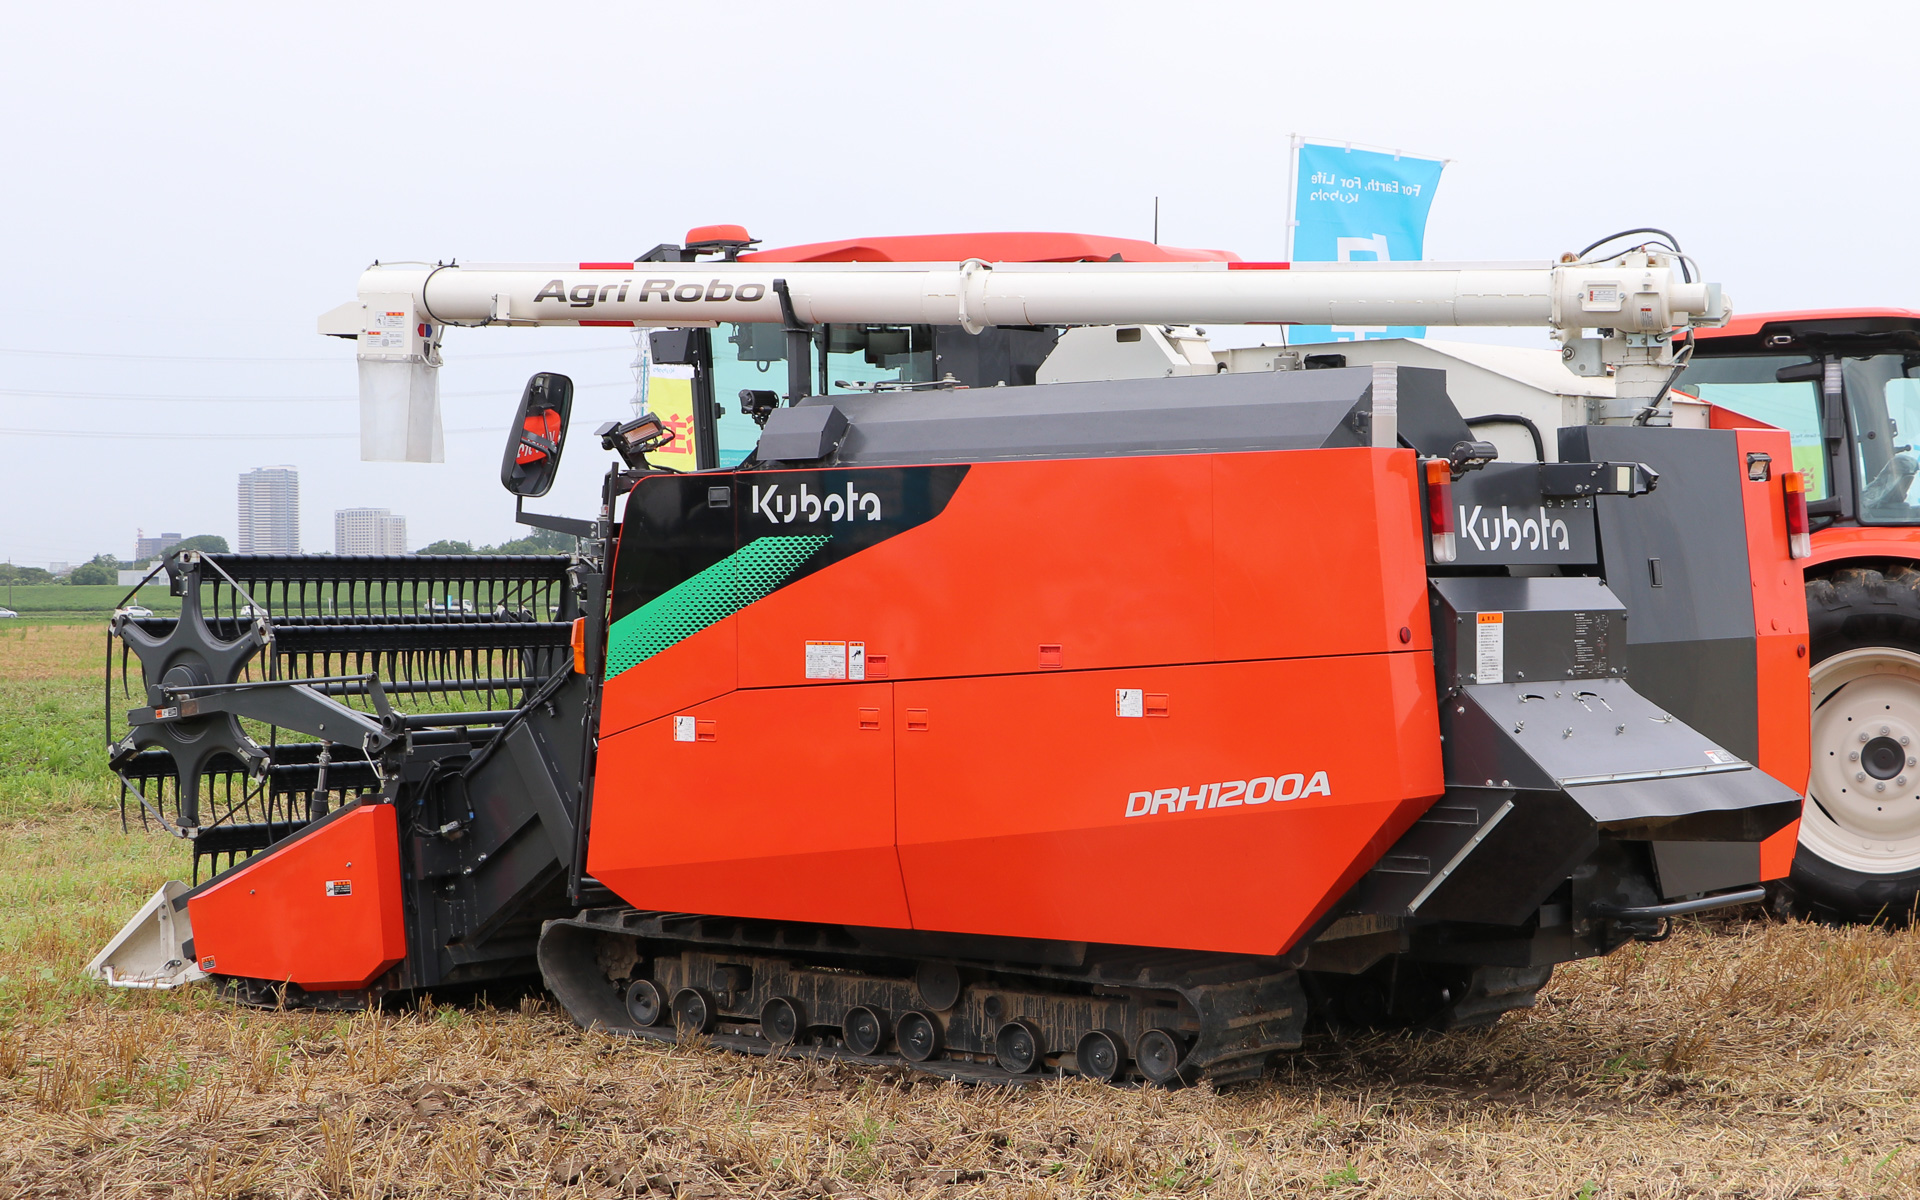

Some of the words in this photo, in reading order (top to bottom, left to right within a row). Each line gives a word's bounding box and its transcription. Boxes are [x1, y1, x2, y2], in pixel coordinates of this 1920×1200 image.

[533, 279, 632, 307] Agri
[638, 279, 766, 303] Robo
[752, 482, 881, 523] Kubota
[1460, 505, 1569, 550] Kubota
[1125, 770, 1331, 817] DRH1200A
